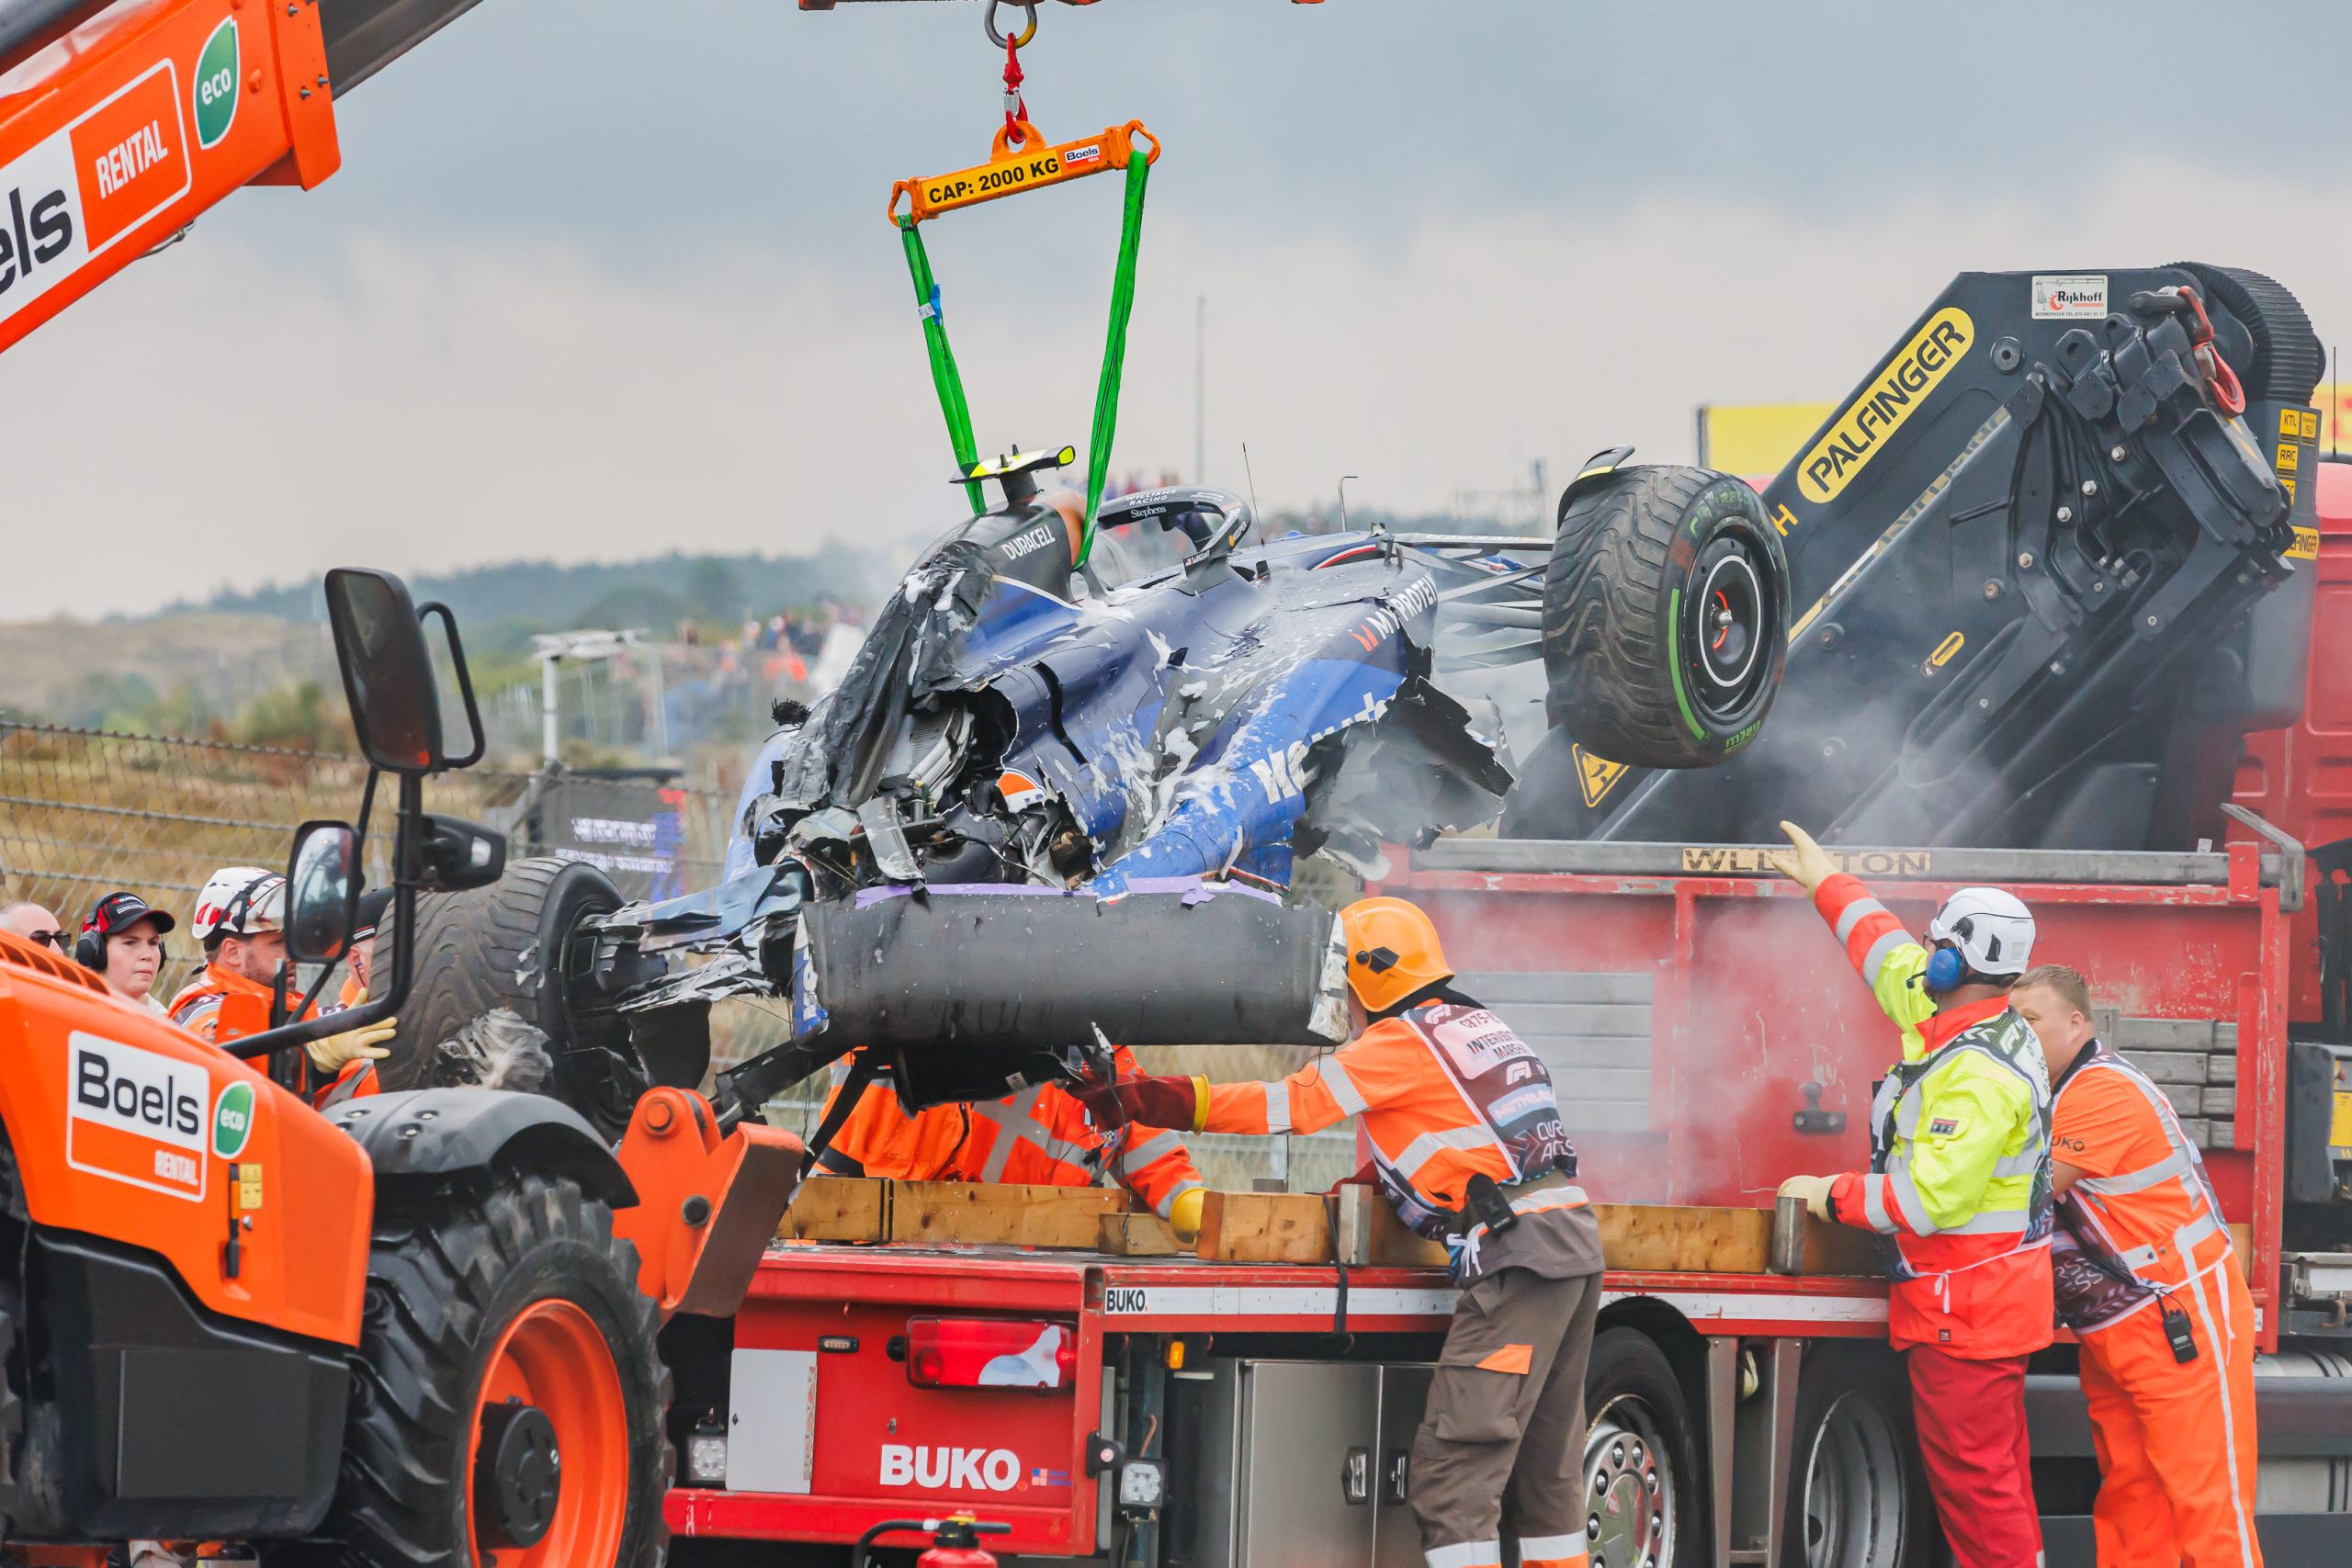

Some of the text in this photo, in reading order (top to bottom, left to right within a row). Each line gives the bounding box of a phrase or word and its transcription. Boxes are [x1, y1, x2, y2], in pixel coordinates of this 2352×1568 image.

[201, 68, 232, 105] eco
[96, 119, 168, 199] RENTAL
[1066, 148, 1099, 161] Boels
[929, 158, 1059, 204] CAP: 2000 KG
[2057, 290, 2103, 305] Rijkhoff
[1806, 321, 1966, 494] PALFINGER
[1125, 490, 1177, 502] WILLIAMS
[1129, 495, 1168, 506] RACING
[1130, 505, 1167, 518] Stephens
[1001, 525, 1056, 560] DURACELL
[1233, 521, 1248, 542] KEEPER
[2292, 533, 2318, 553] FINGER
[78, 1050, 199, 1136] Boels
[219, 1106, 245, 1132] eco
[154, 1150, 199, 1186] RENTAL
